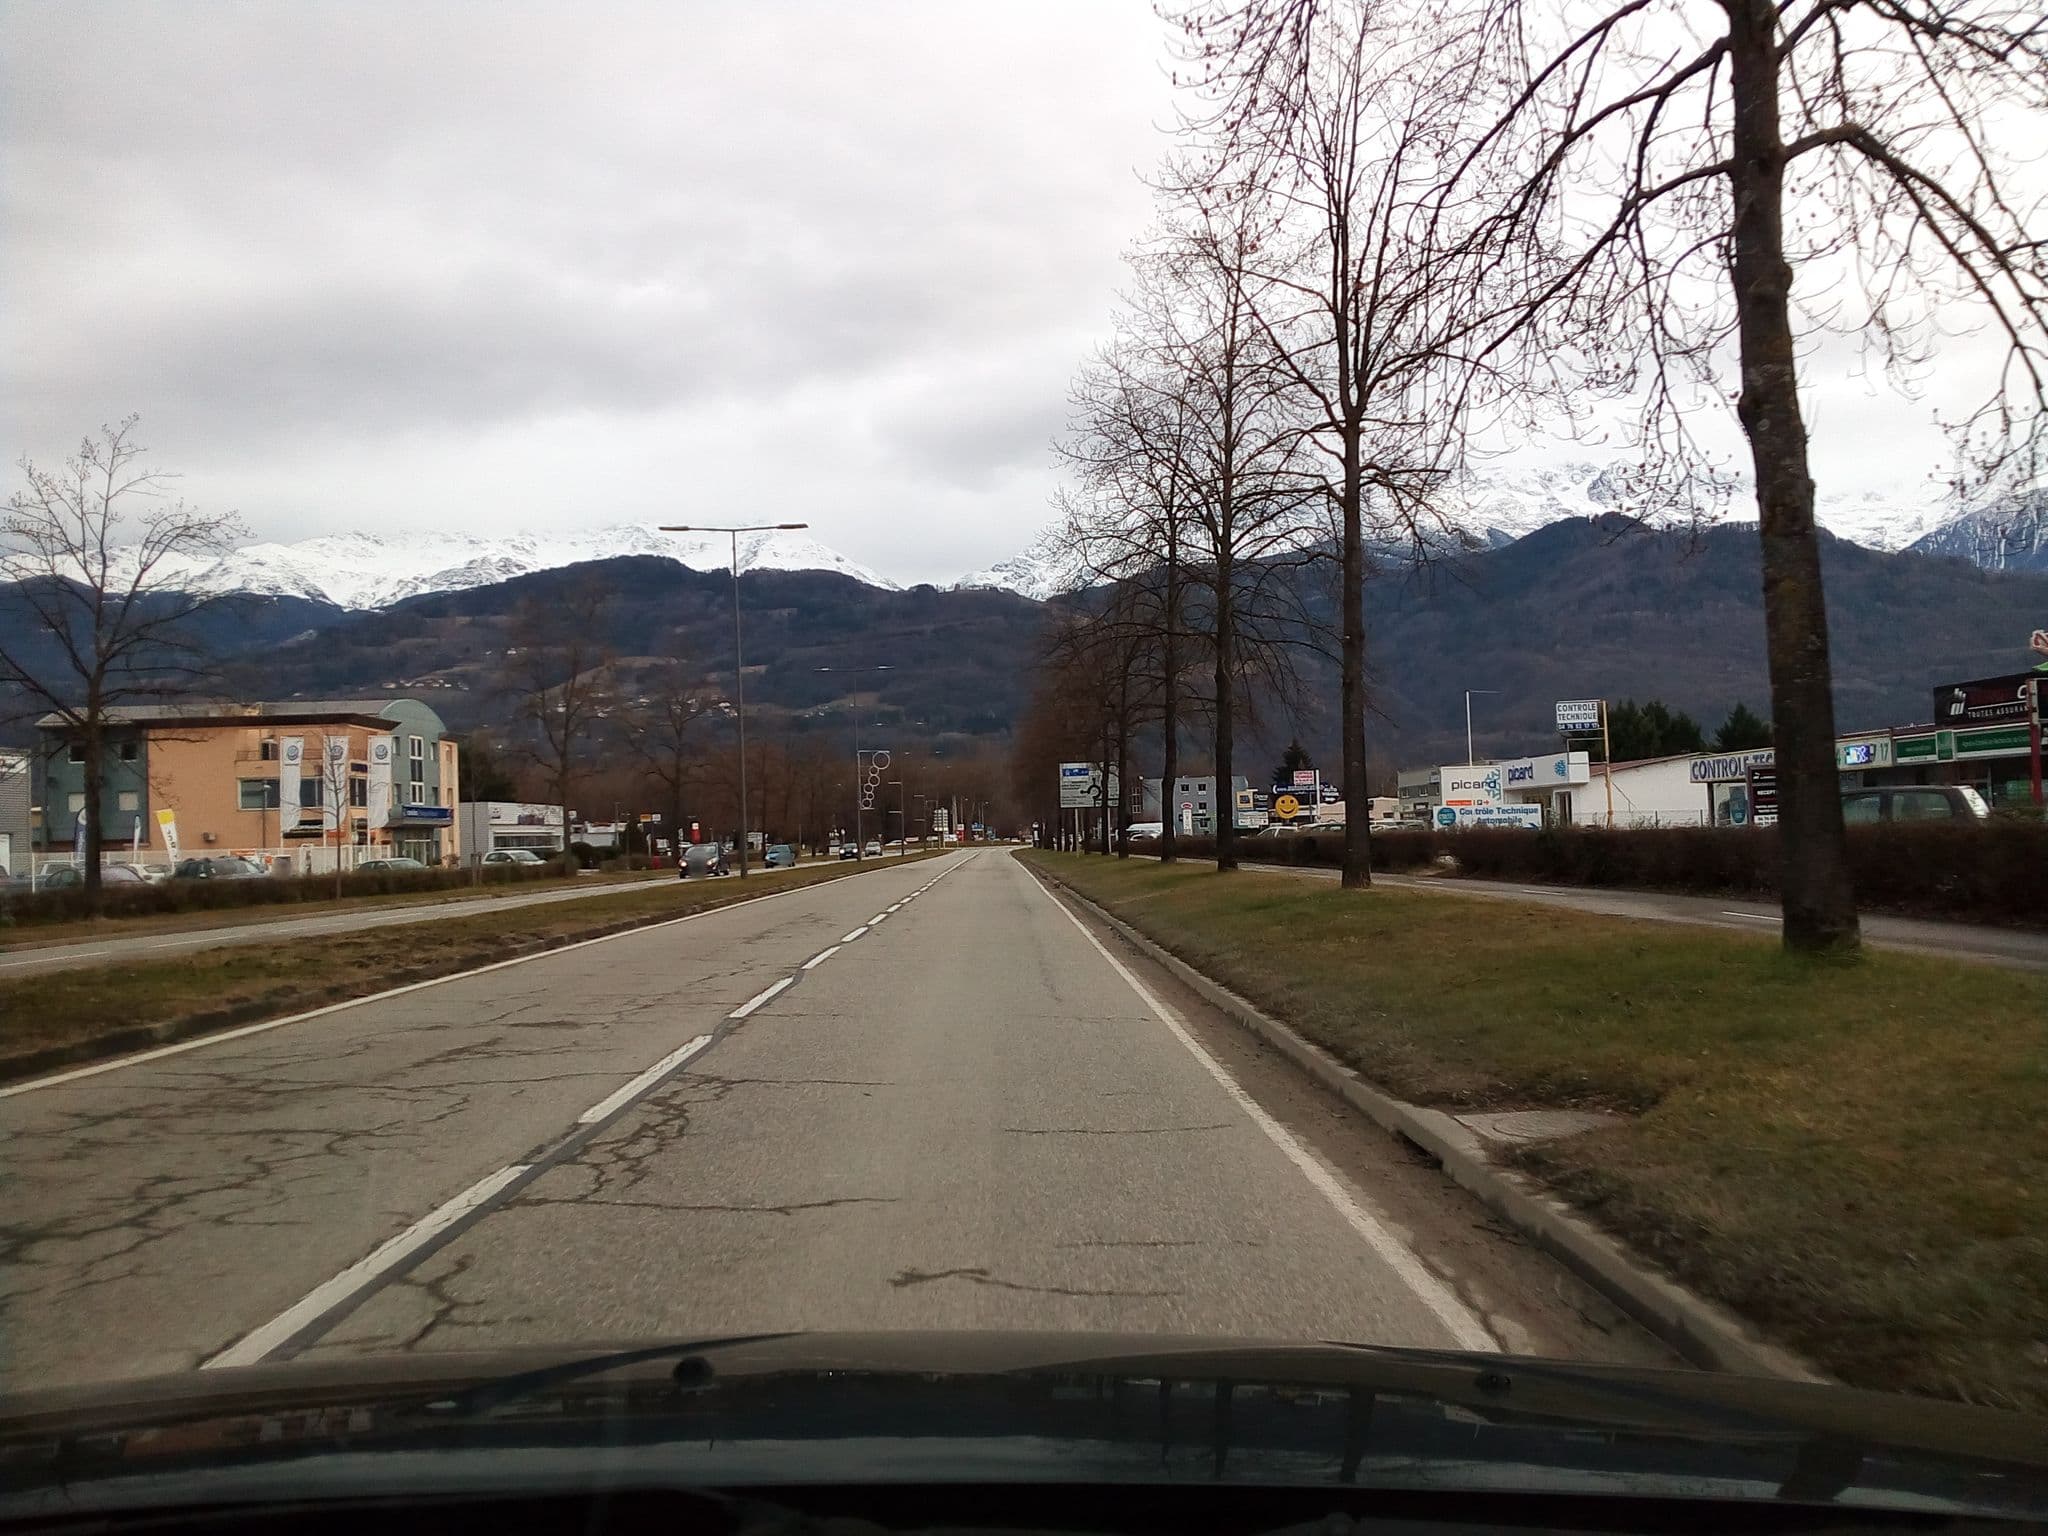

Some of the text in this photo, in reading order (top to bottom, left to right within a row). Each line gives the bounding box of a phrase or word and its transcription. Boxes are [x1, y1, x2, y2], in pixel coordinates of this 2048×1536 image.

[1557, 704, 1596, 712] CONTROLE
[1508, 762, 1533, 785] picard
[1451, 780, 1497, 791] picard
[1496, 807, 1539, 816] Technique
